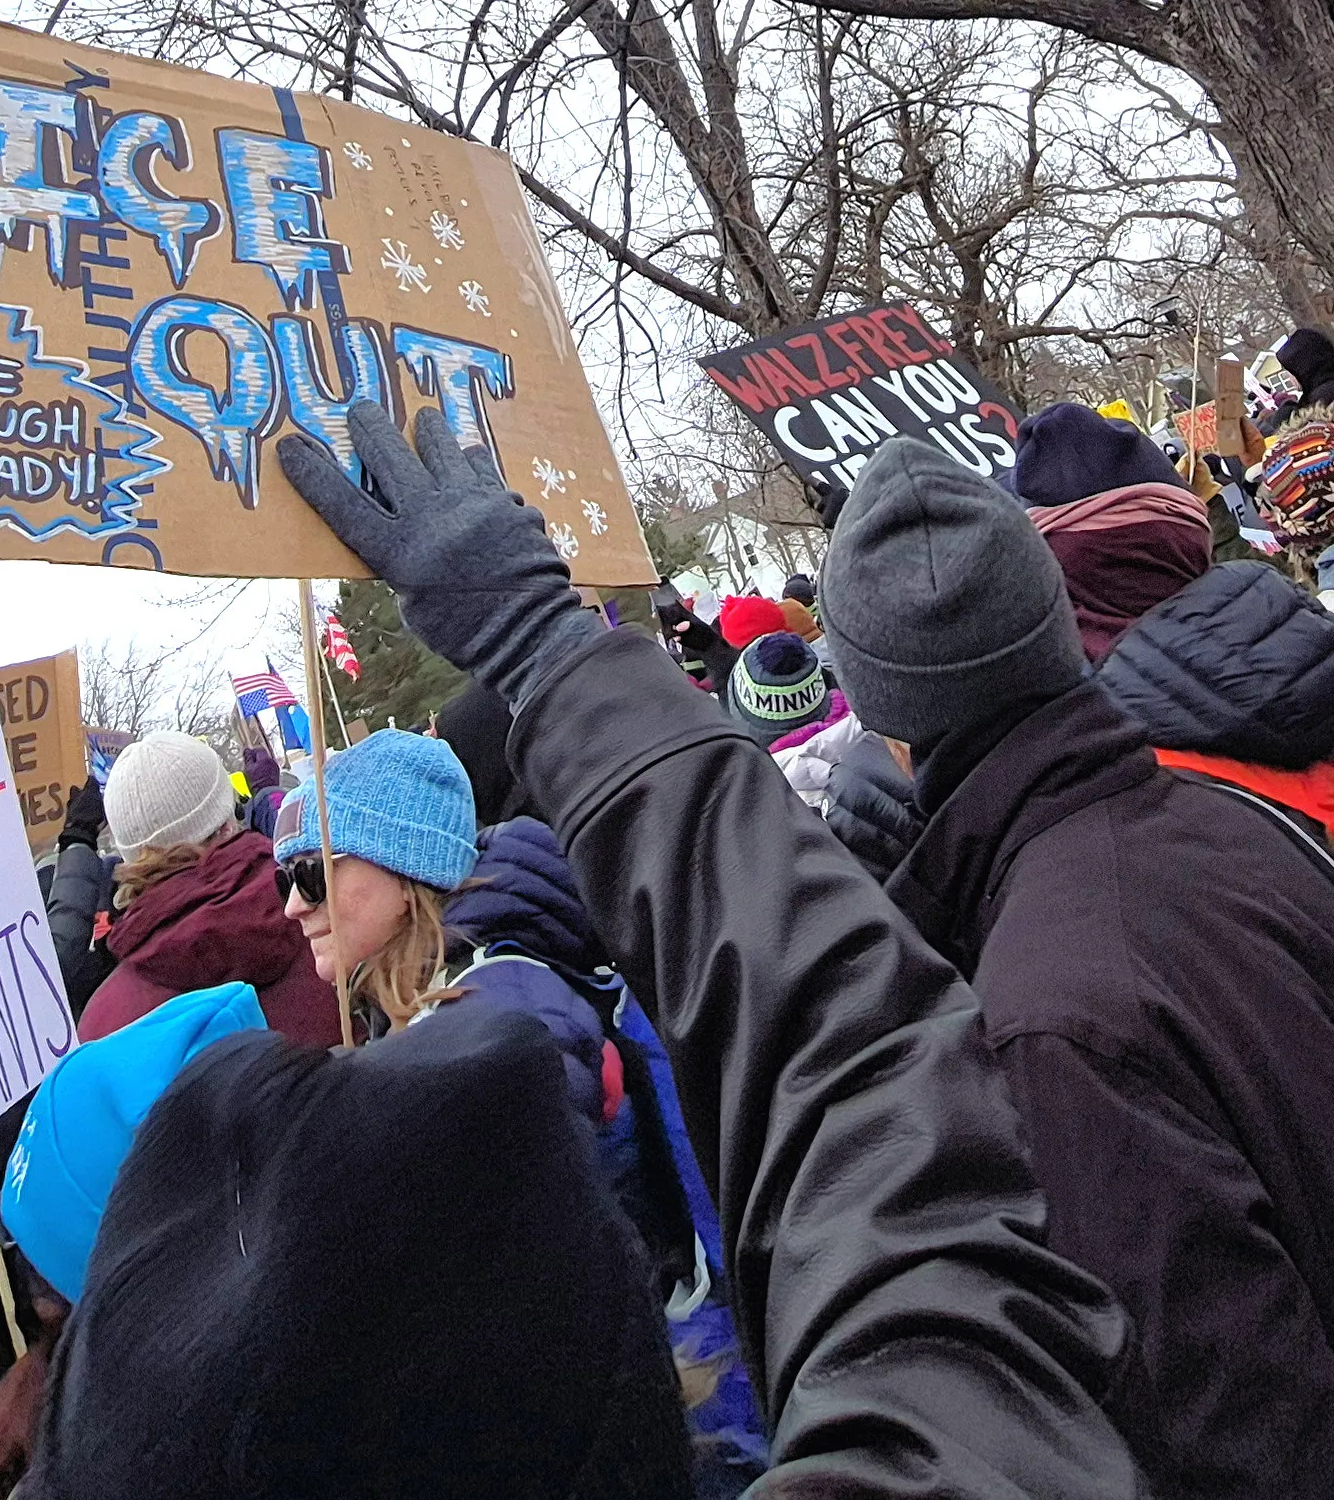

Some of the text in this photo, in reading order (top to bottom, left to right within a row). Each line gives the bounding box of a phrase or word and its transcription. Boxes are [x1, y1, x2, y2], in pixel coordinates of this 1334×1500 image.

[127, 295, 515, 510] OUT
[774, 358, 981, 463] CAN YOU
[6, 732, 38, 773] E
